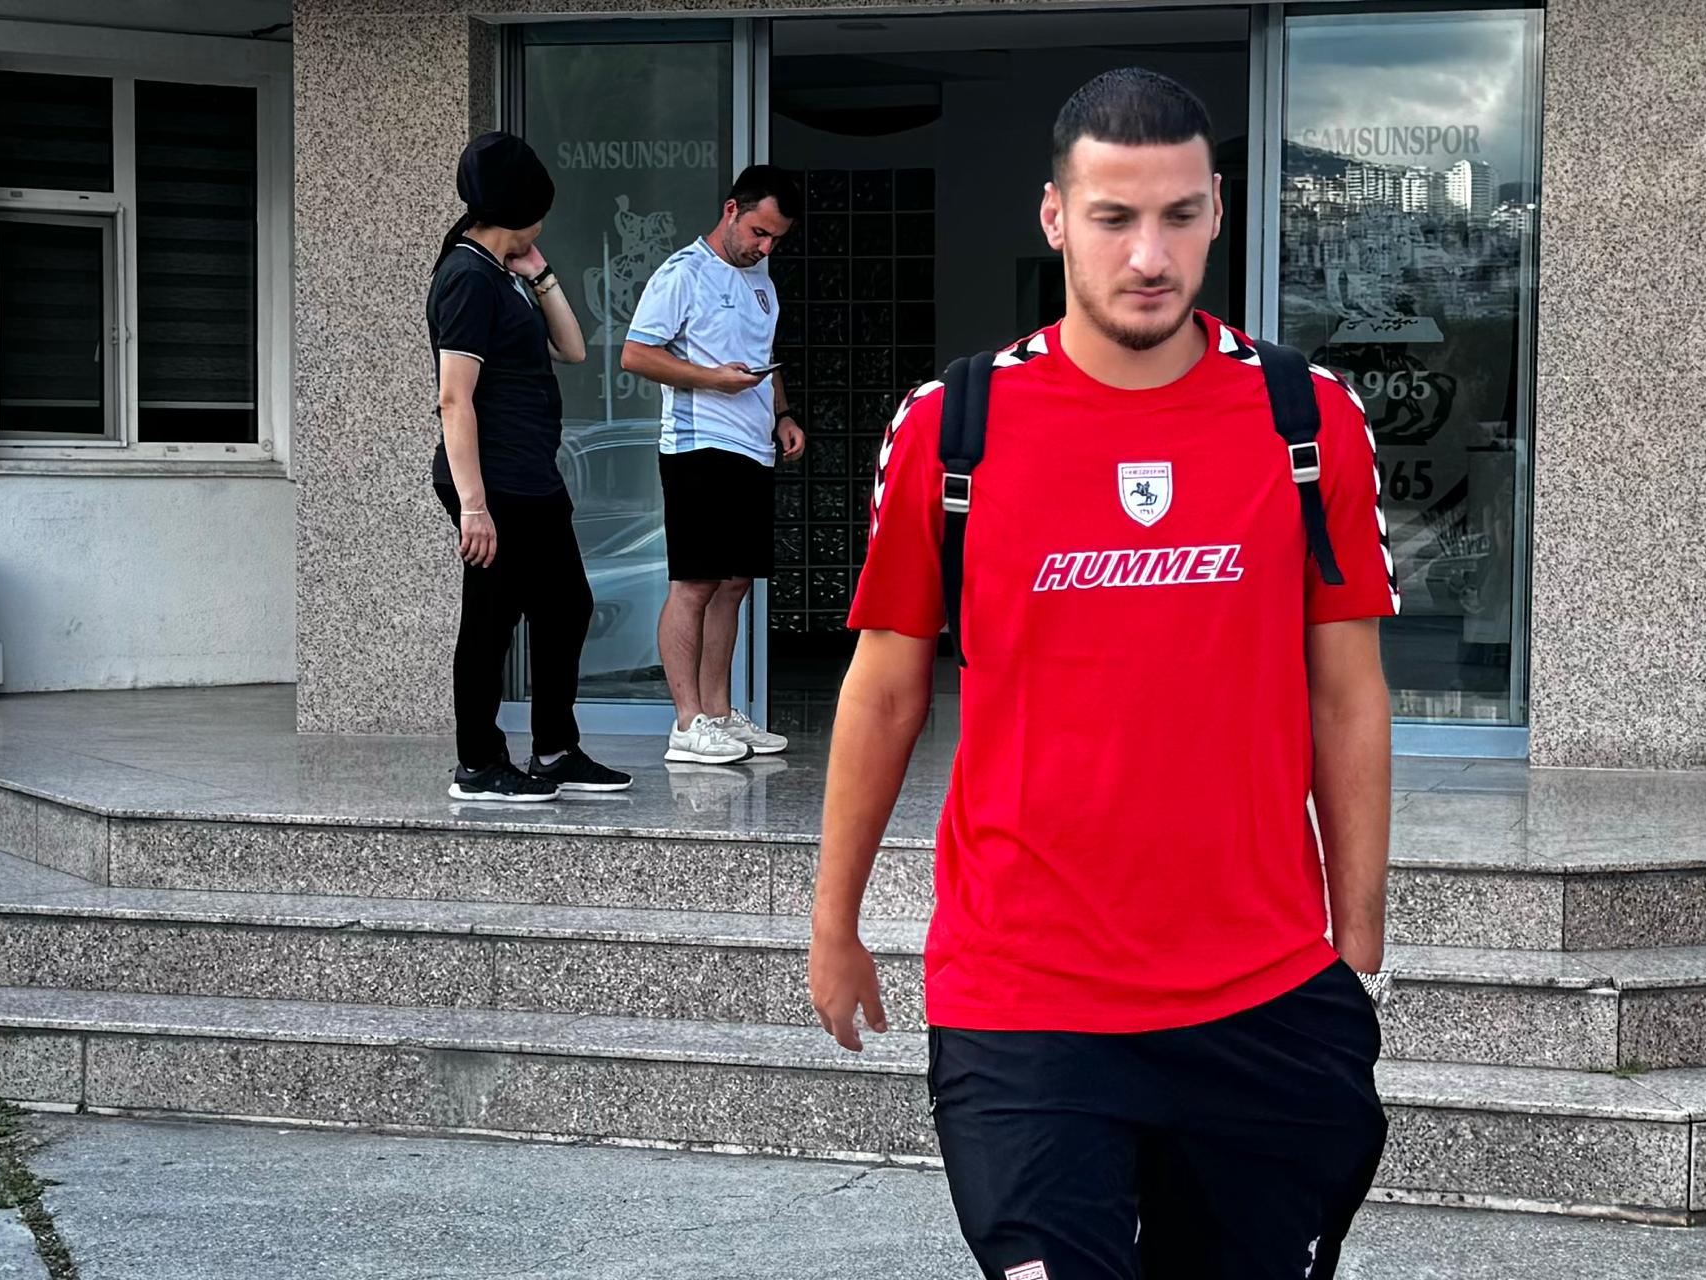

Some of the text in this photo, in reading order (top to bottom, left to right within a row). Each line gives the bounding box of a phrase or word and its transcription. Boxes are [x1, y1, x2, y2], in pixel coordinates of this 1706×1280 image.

[556, 140, 718, 169] SAMSUNSPOR
[1302, 124, 1481, 158] SAMSUNSPOR
[597, 371, 659, 401] 196
[1033, 544, 1245, 592] HUMMEL
